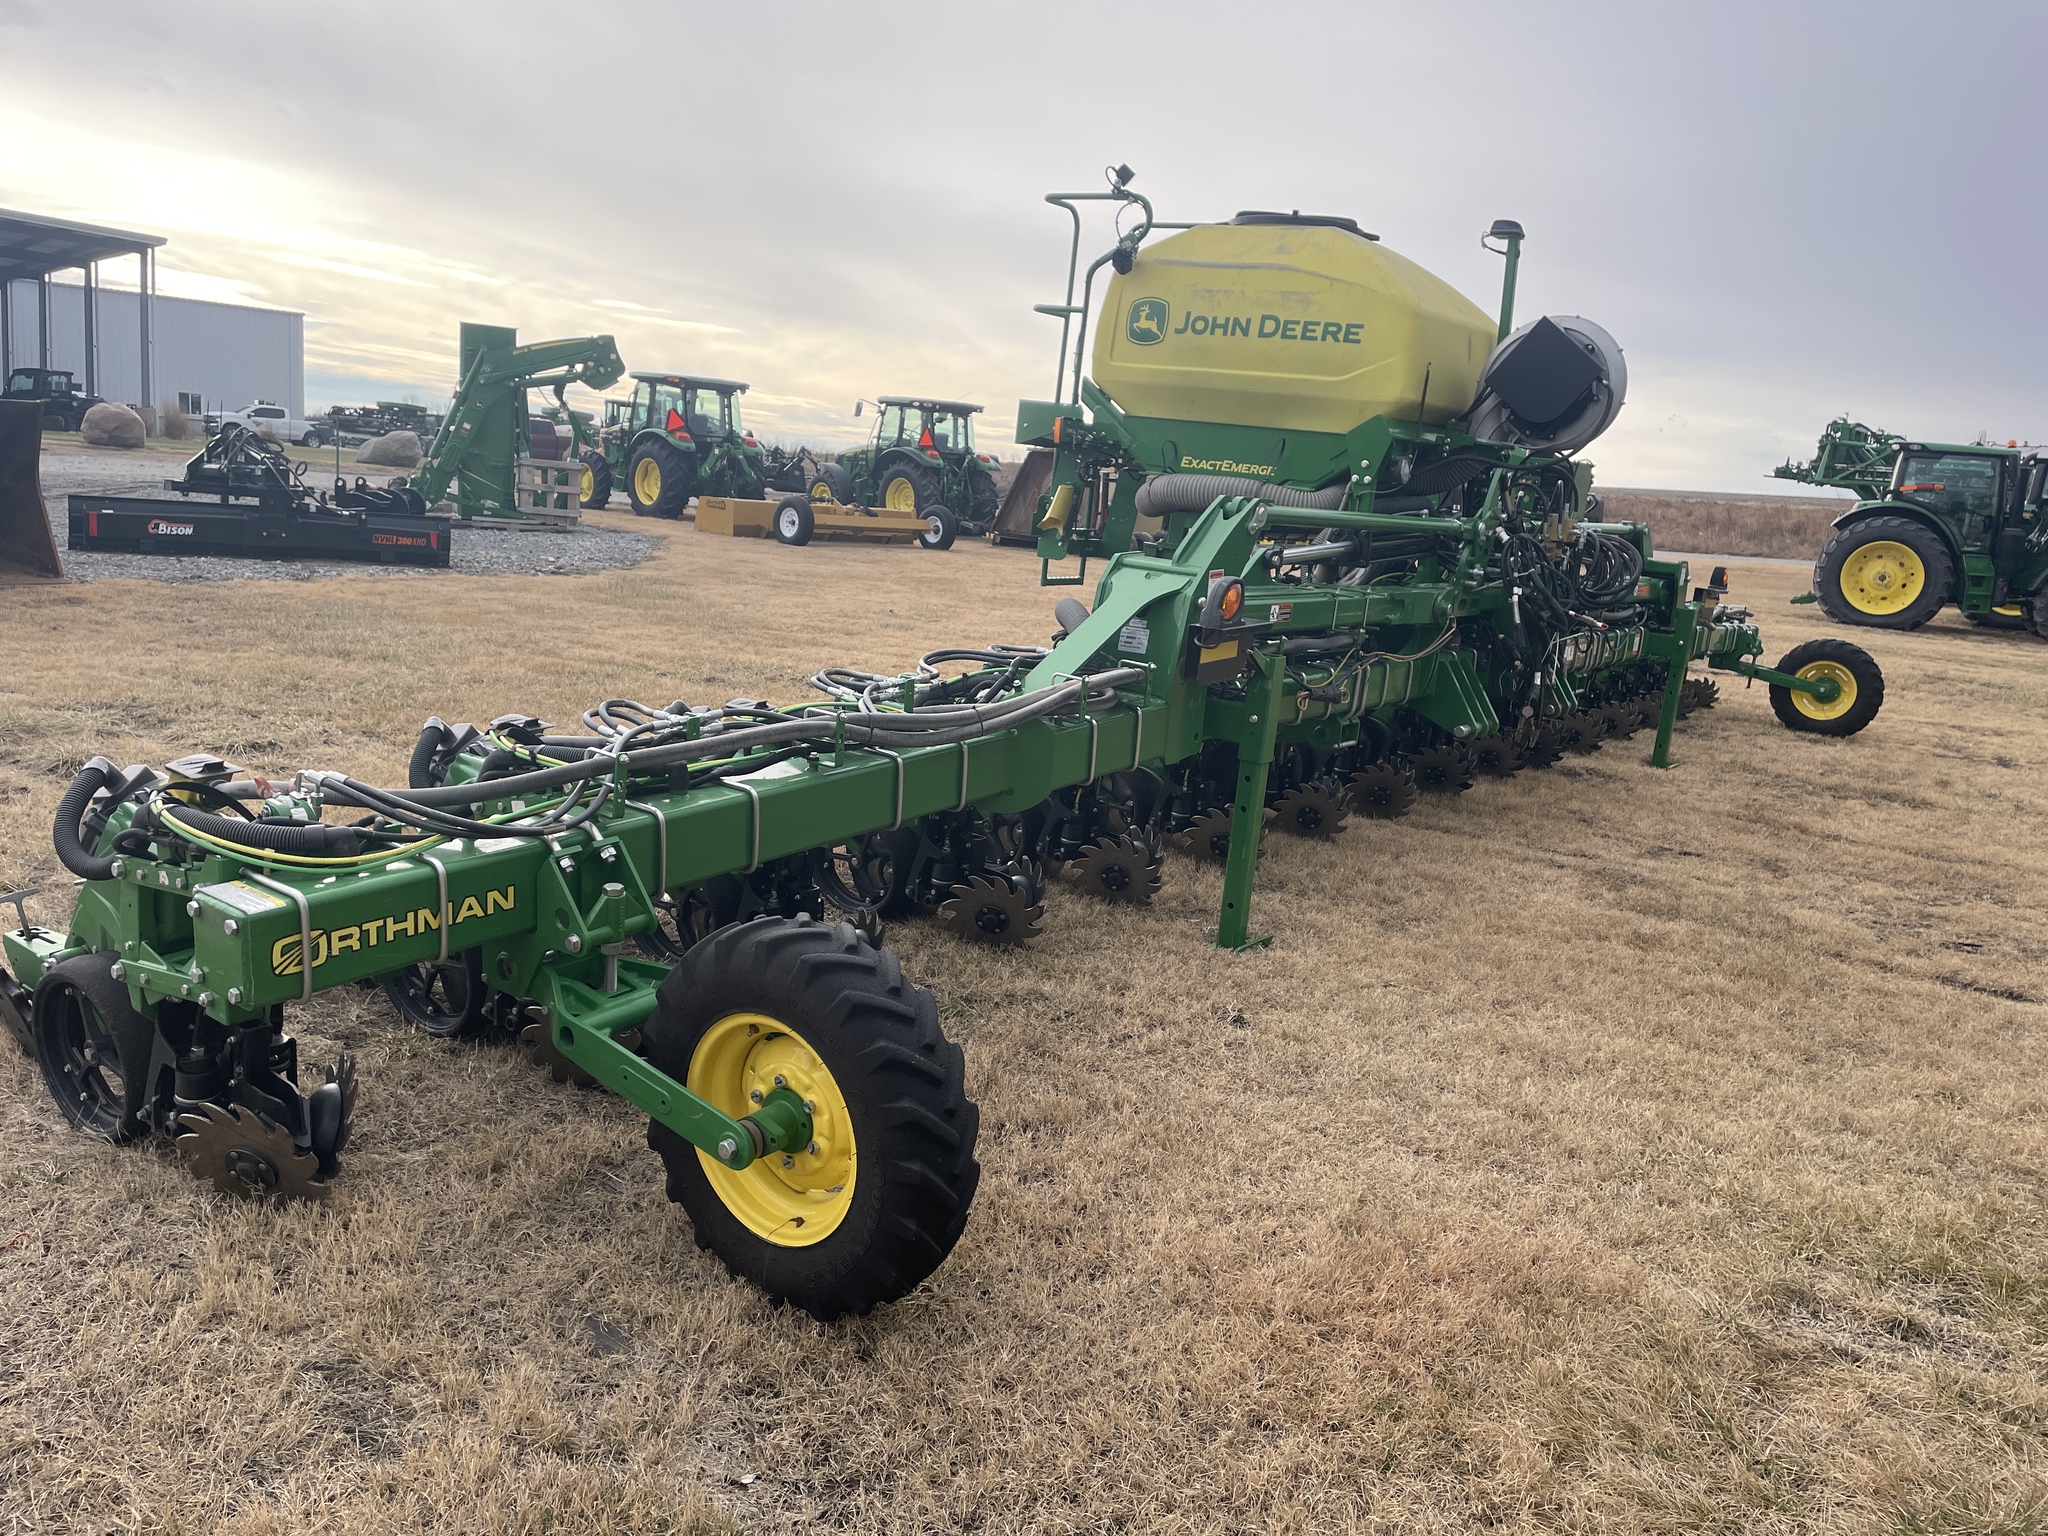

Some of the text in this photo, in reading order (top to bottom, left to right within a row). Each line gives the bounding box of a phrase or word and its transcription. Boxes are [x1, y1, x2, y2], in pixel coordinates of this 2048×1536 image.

[1174, 311, 1365, 344] JOHN DEERE
[158, 523, 194, 536] BISON
[271, 885, 516, 977] ORTHMAN
